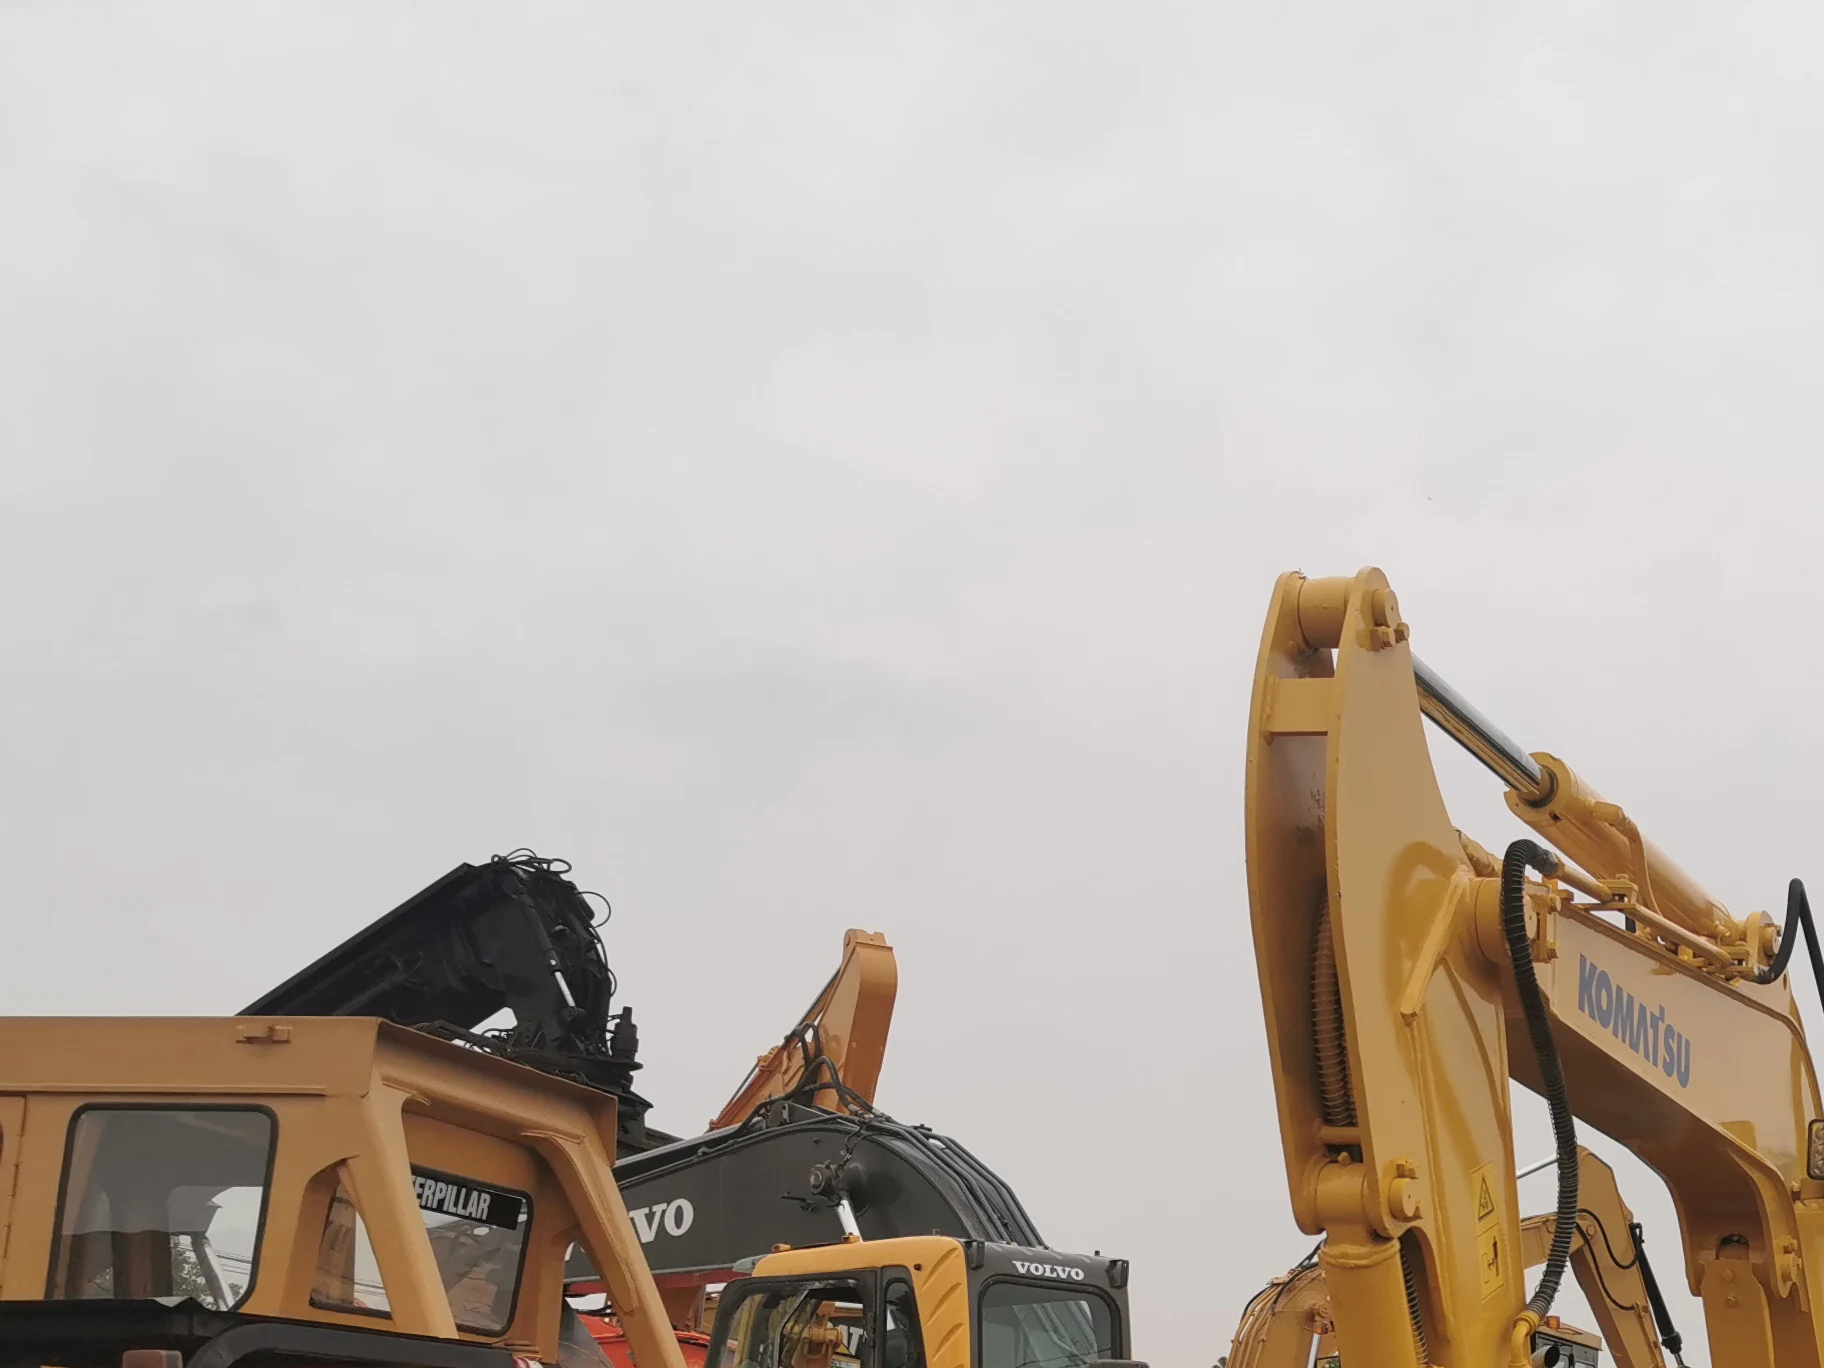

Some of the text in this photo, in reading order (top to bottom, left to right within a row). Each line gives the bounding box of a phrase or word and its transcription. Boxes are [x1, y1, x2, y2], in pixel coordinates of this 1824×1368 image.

[1578, 953, 1690, 1088] KOMATSU
[412, 1176, 491, 1220] ERPILLAR
[1012, 1261, 1085, 1281] VOLVO
